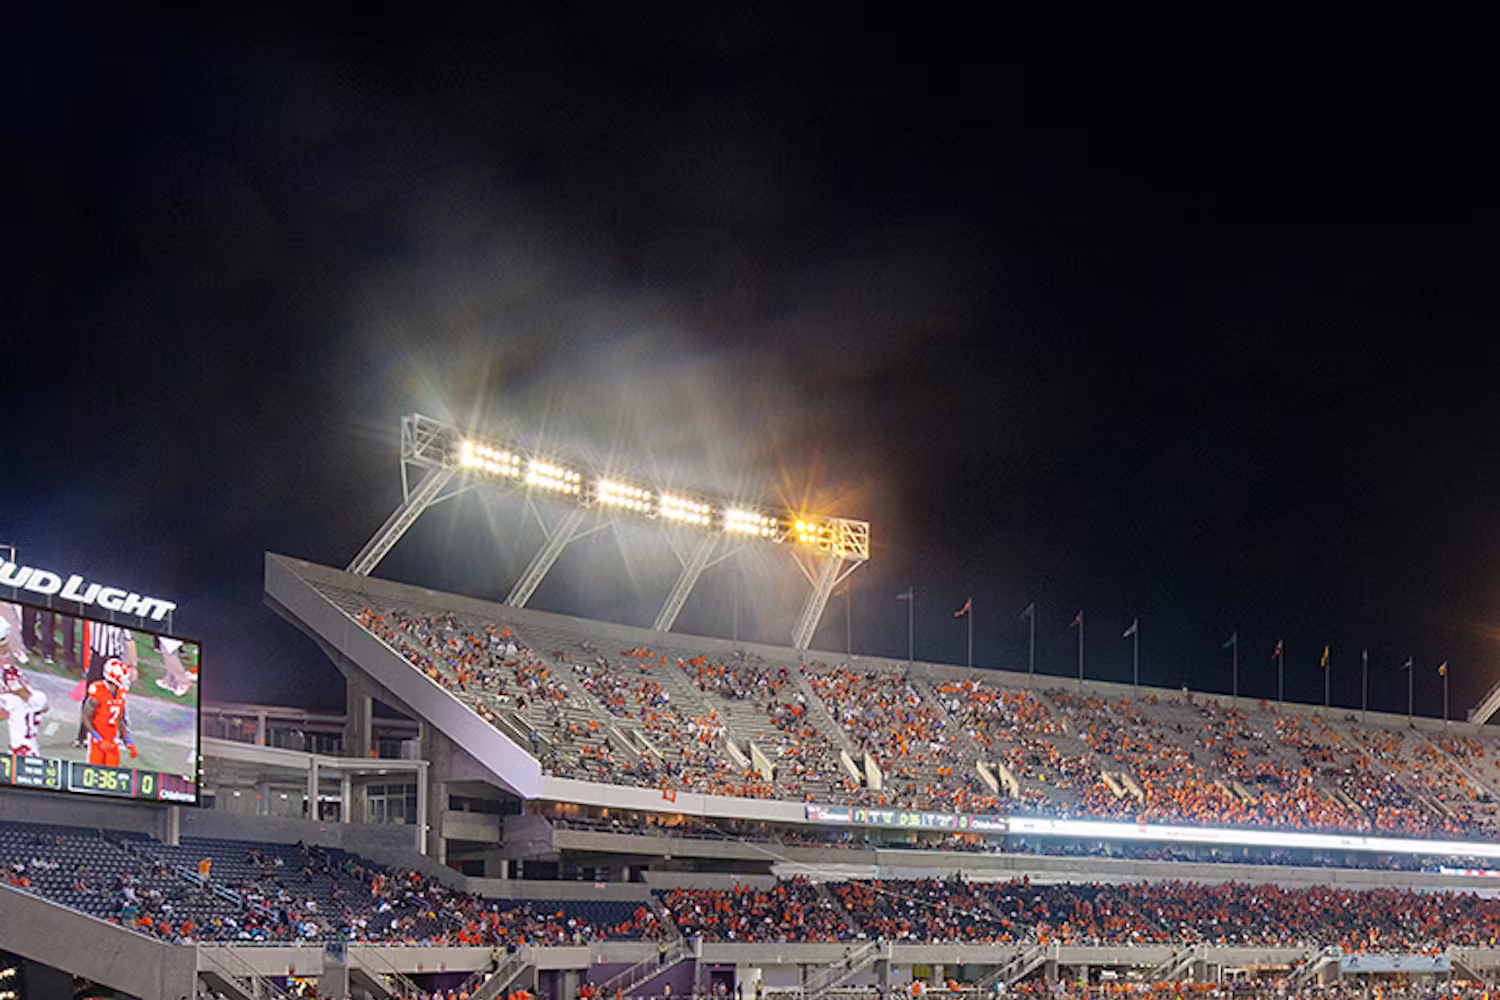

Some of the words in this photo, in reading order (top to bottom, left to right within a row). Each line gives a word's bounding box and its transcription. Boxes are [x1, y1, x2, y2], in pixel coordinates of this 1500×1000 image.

[0, 557, 63, 595] UD
[60, 575, 177, 621] LIGHT
[83, 768, 118, 790] 0:36
[142, 775, 153, 794] 0
